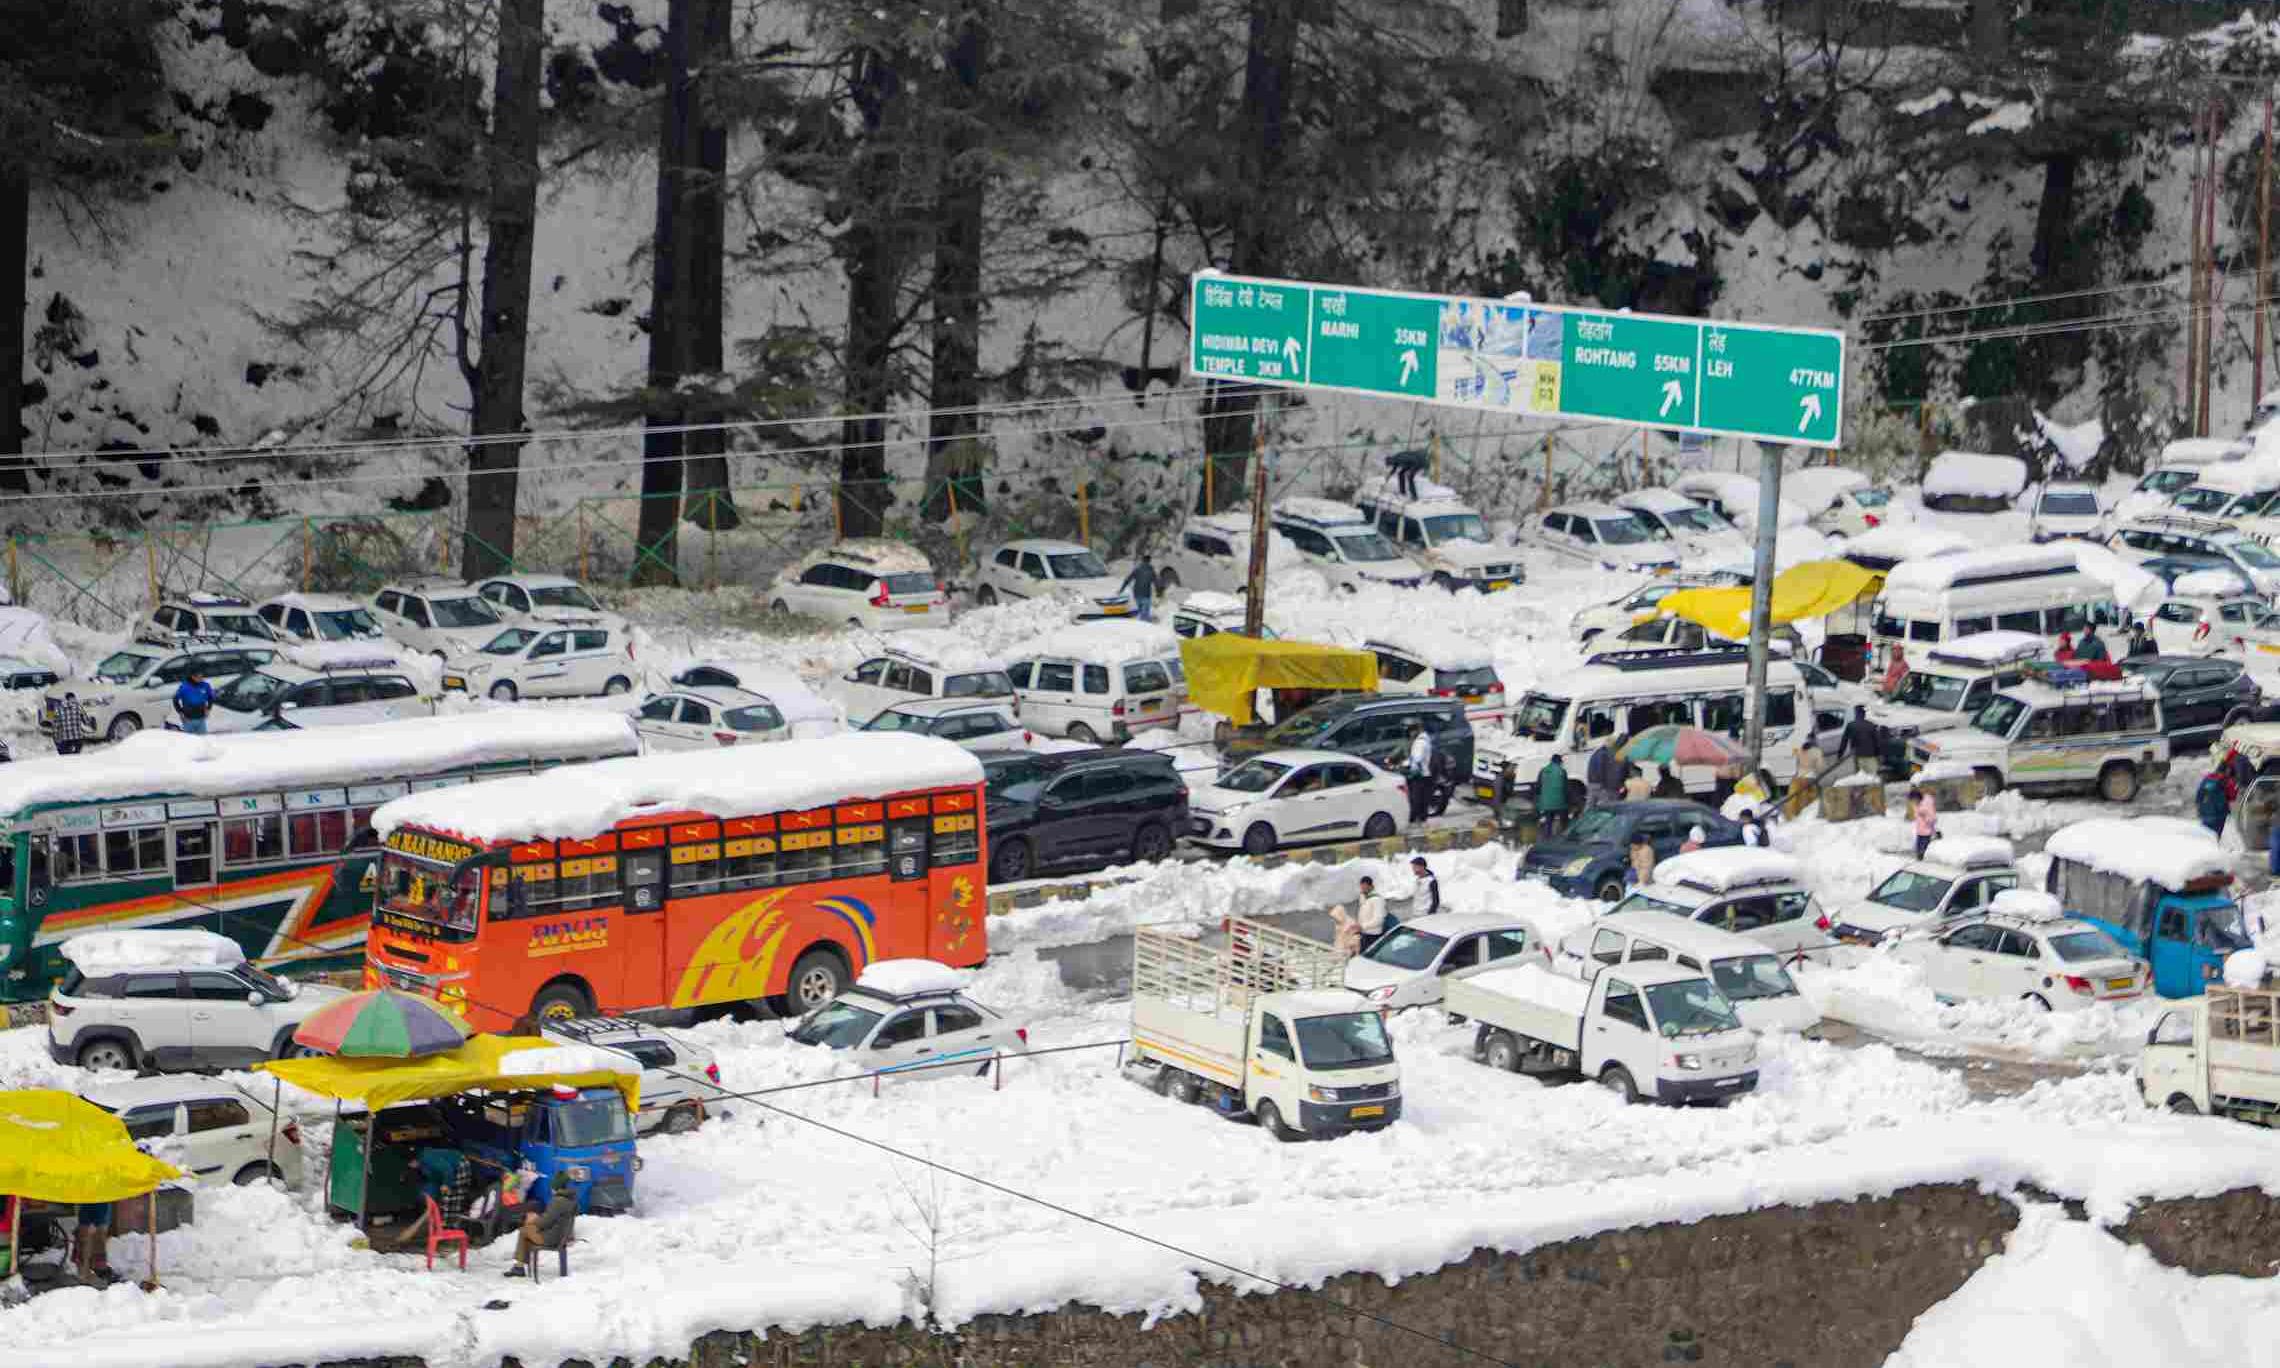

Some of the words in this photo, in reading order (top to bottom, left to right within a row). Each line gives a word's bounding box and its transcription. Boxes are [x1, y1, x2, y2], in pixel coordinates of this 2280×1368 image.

[1252, 337, 1279, 355] DEVI
[1200, 354, 1245, 375] TEMPLE
[1574, 346, 1638, 369] ROHTANG
[1654, 353, 1691, 374] 55KM
[1706, 358, 1734, 379] LEH
[1789, 367, 1835, 390] 477KM
